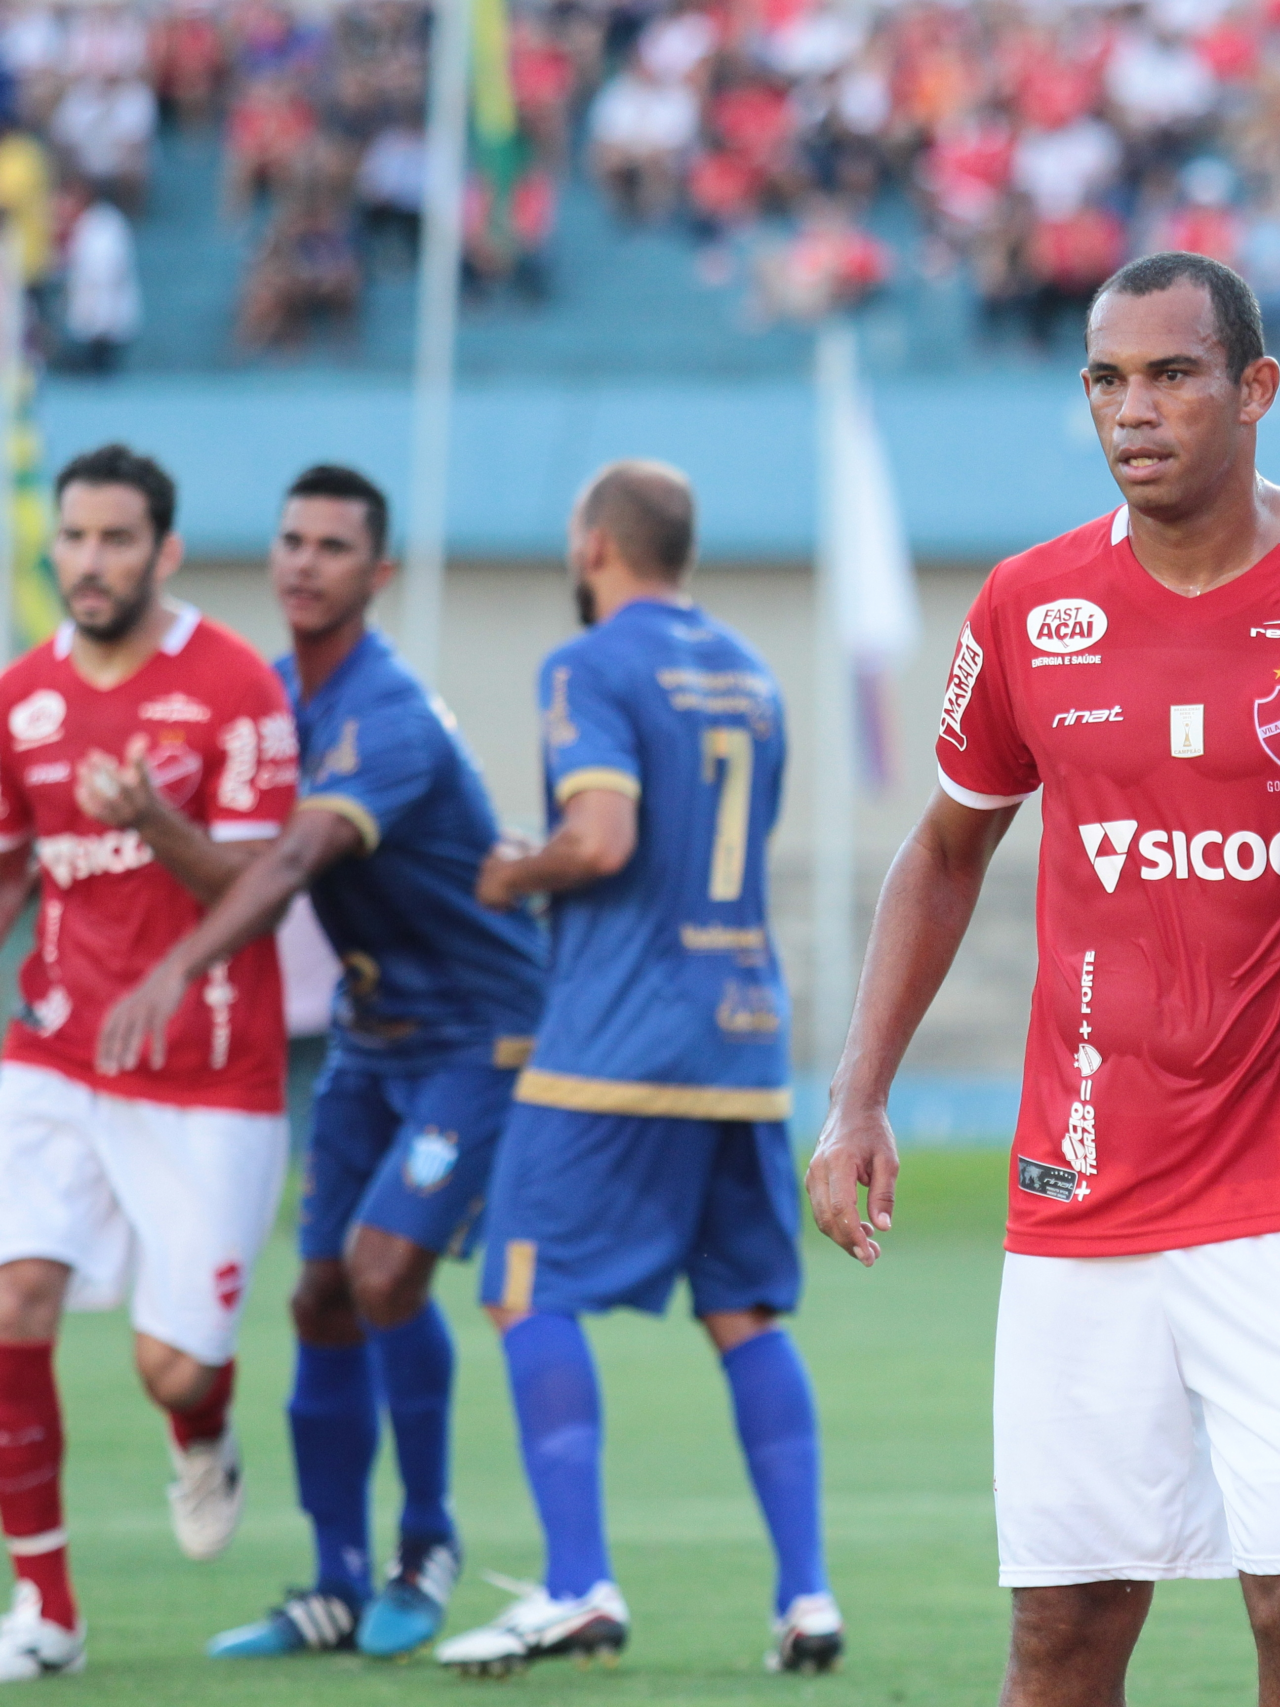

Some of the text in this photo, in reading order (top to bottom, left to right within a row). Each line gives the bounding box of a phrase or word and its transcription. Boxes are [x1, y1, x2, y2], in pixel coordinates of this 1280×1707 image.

[1043, 607, 1082, 622] FAST
[1036, 614, 1095, 647] AÇAÍ
[1032, 653, 1102, 668] ENERGIA E SAÚDE
[1052, 705, 1124, 728] rinat
[1261, 724, 1280, 735] VILA
[703, 727, 754, 902] 7
[1081, 950, 1096, 1014] FORTE
[1081, 1104, 1098, 1176] TIGRÃO
